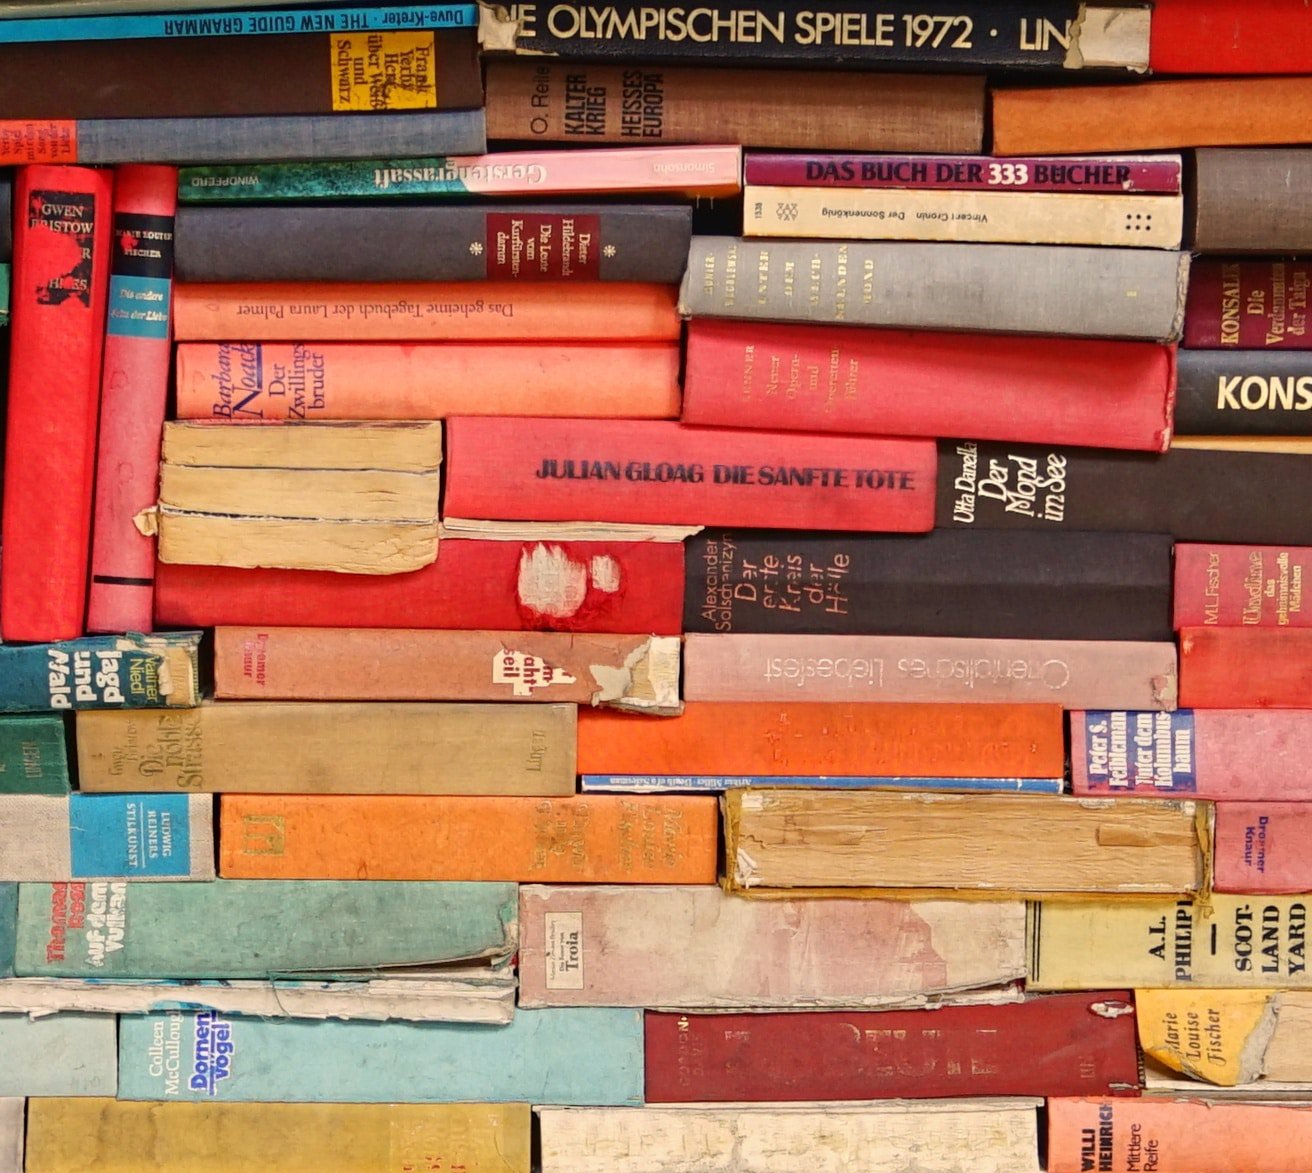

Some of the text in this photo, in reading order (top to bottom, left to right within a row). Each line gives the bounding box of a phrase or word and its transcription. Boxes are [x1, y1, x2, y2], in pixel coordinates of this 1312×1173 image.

[548, 5, 973, 49] OLYMPISCHEN SPIELE 1972
[806, 160, 1130, 186] DAS BUCH DER 333 BÜCHER
[536, 459, 915, 491] JULIAN GLOAG DIE SANFTE TOTE
[566, 932, 579, 972] Troia
[1235, 903, 1252, 971] SCOT-
[1262, 905, 1280, 974] LAND
[1288, 904, 1306, 976] YARD
[191, 1012, 209, 1089] Dornen
[215, 1021, 232, 1081] vogel
[1127, 1122, 1141, 1172] Mittlere
[1145, 1140, 1158, 1171] Reife
